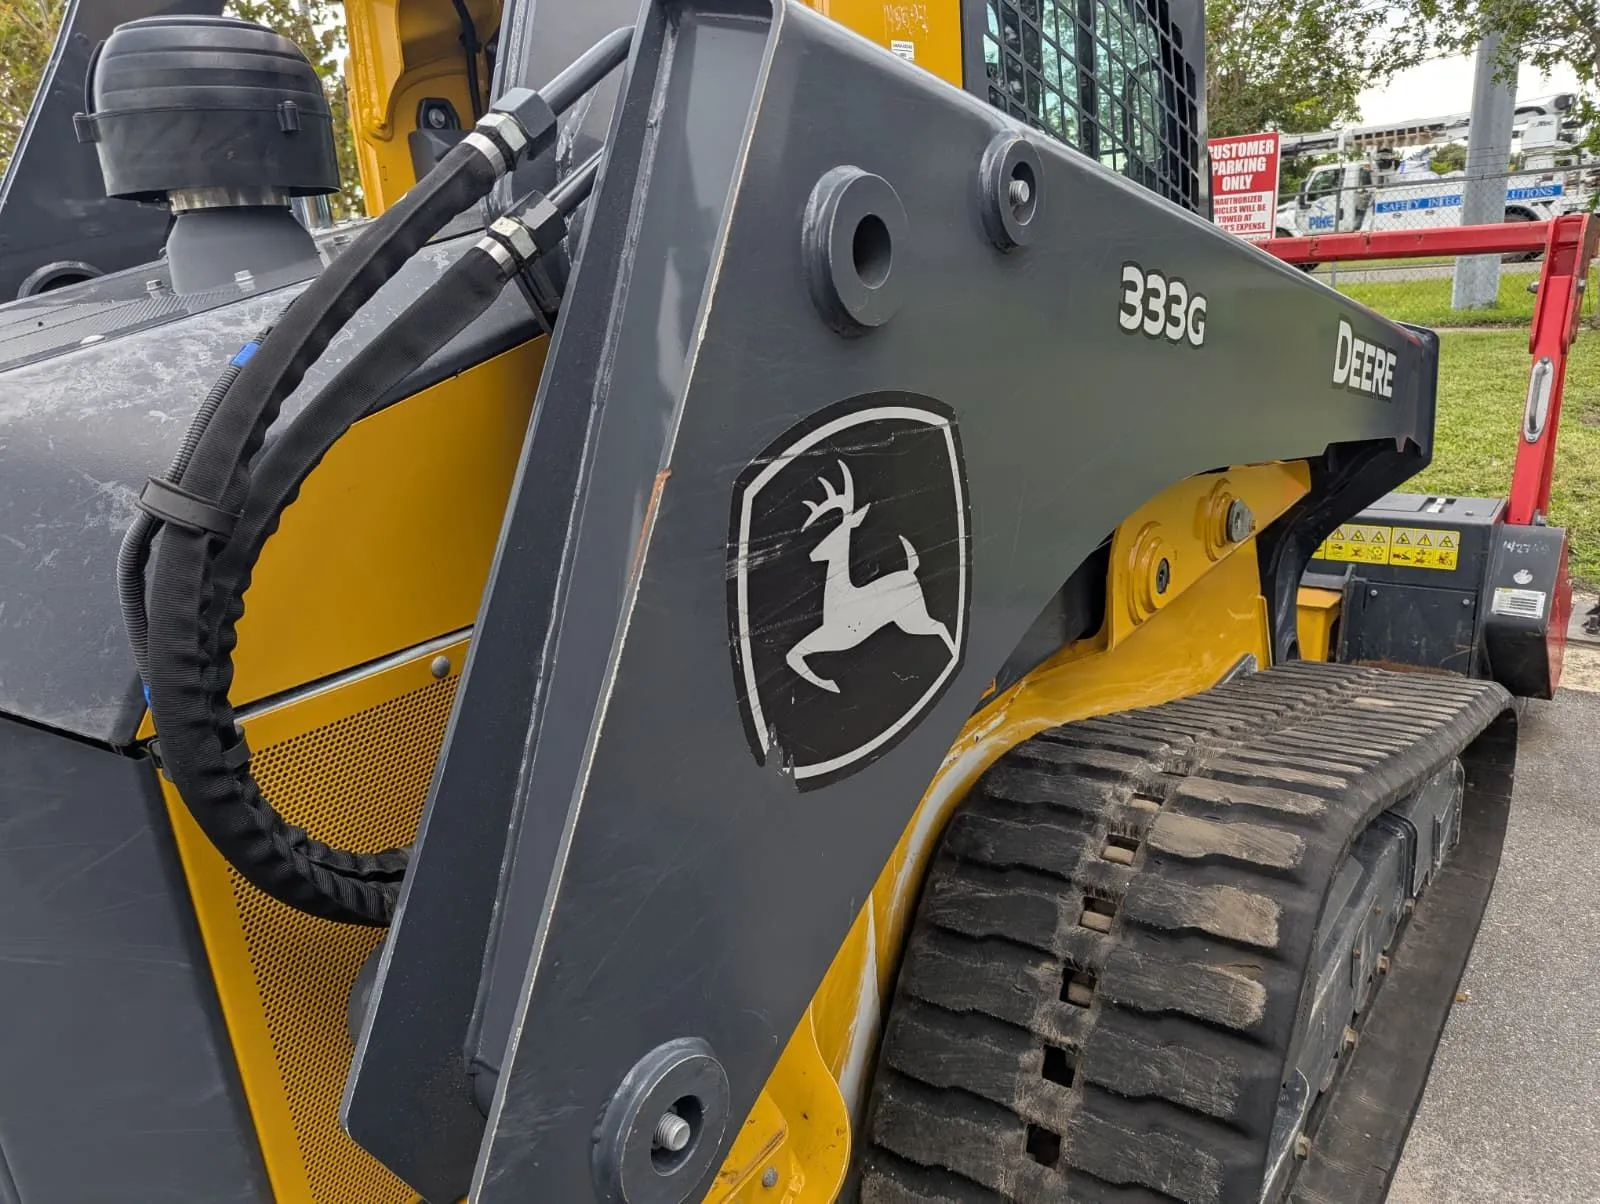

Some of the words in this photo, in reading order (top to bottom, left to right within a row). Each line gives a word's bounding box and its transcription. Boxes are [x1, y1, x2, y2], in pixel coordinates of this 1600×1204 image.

[1212, 157, 1267, 176] PARKING
[1222, 174, 1253, 191] ONLY
[1215, 195, 1262, 205] NAUTHORIZED
[1382, 200, 1421, 212] SAFETY
[1214, 207, 1237, 215] HICLES
[1239, 204, 1256, 213] WILL
[1218, 215, 1242, 223] TOWED
[1236, 222, 1265, 231] EXPENSE
[1118, 265, 1207, 346] 333G
[1332, 319, 1397, 398] DEERE
